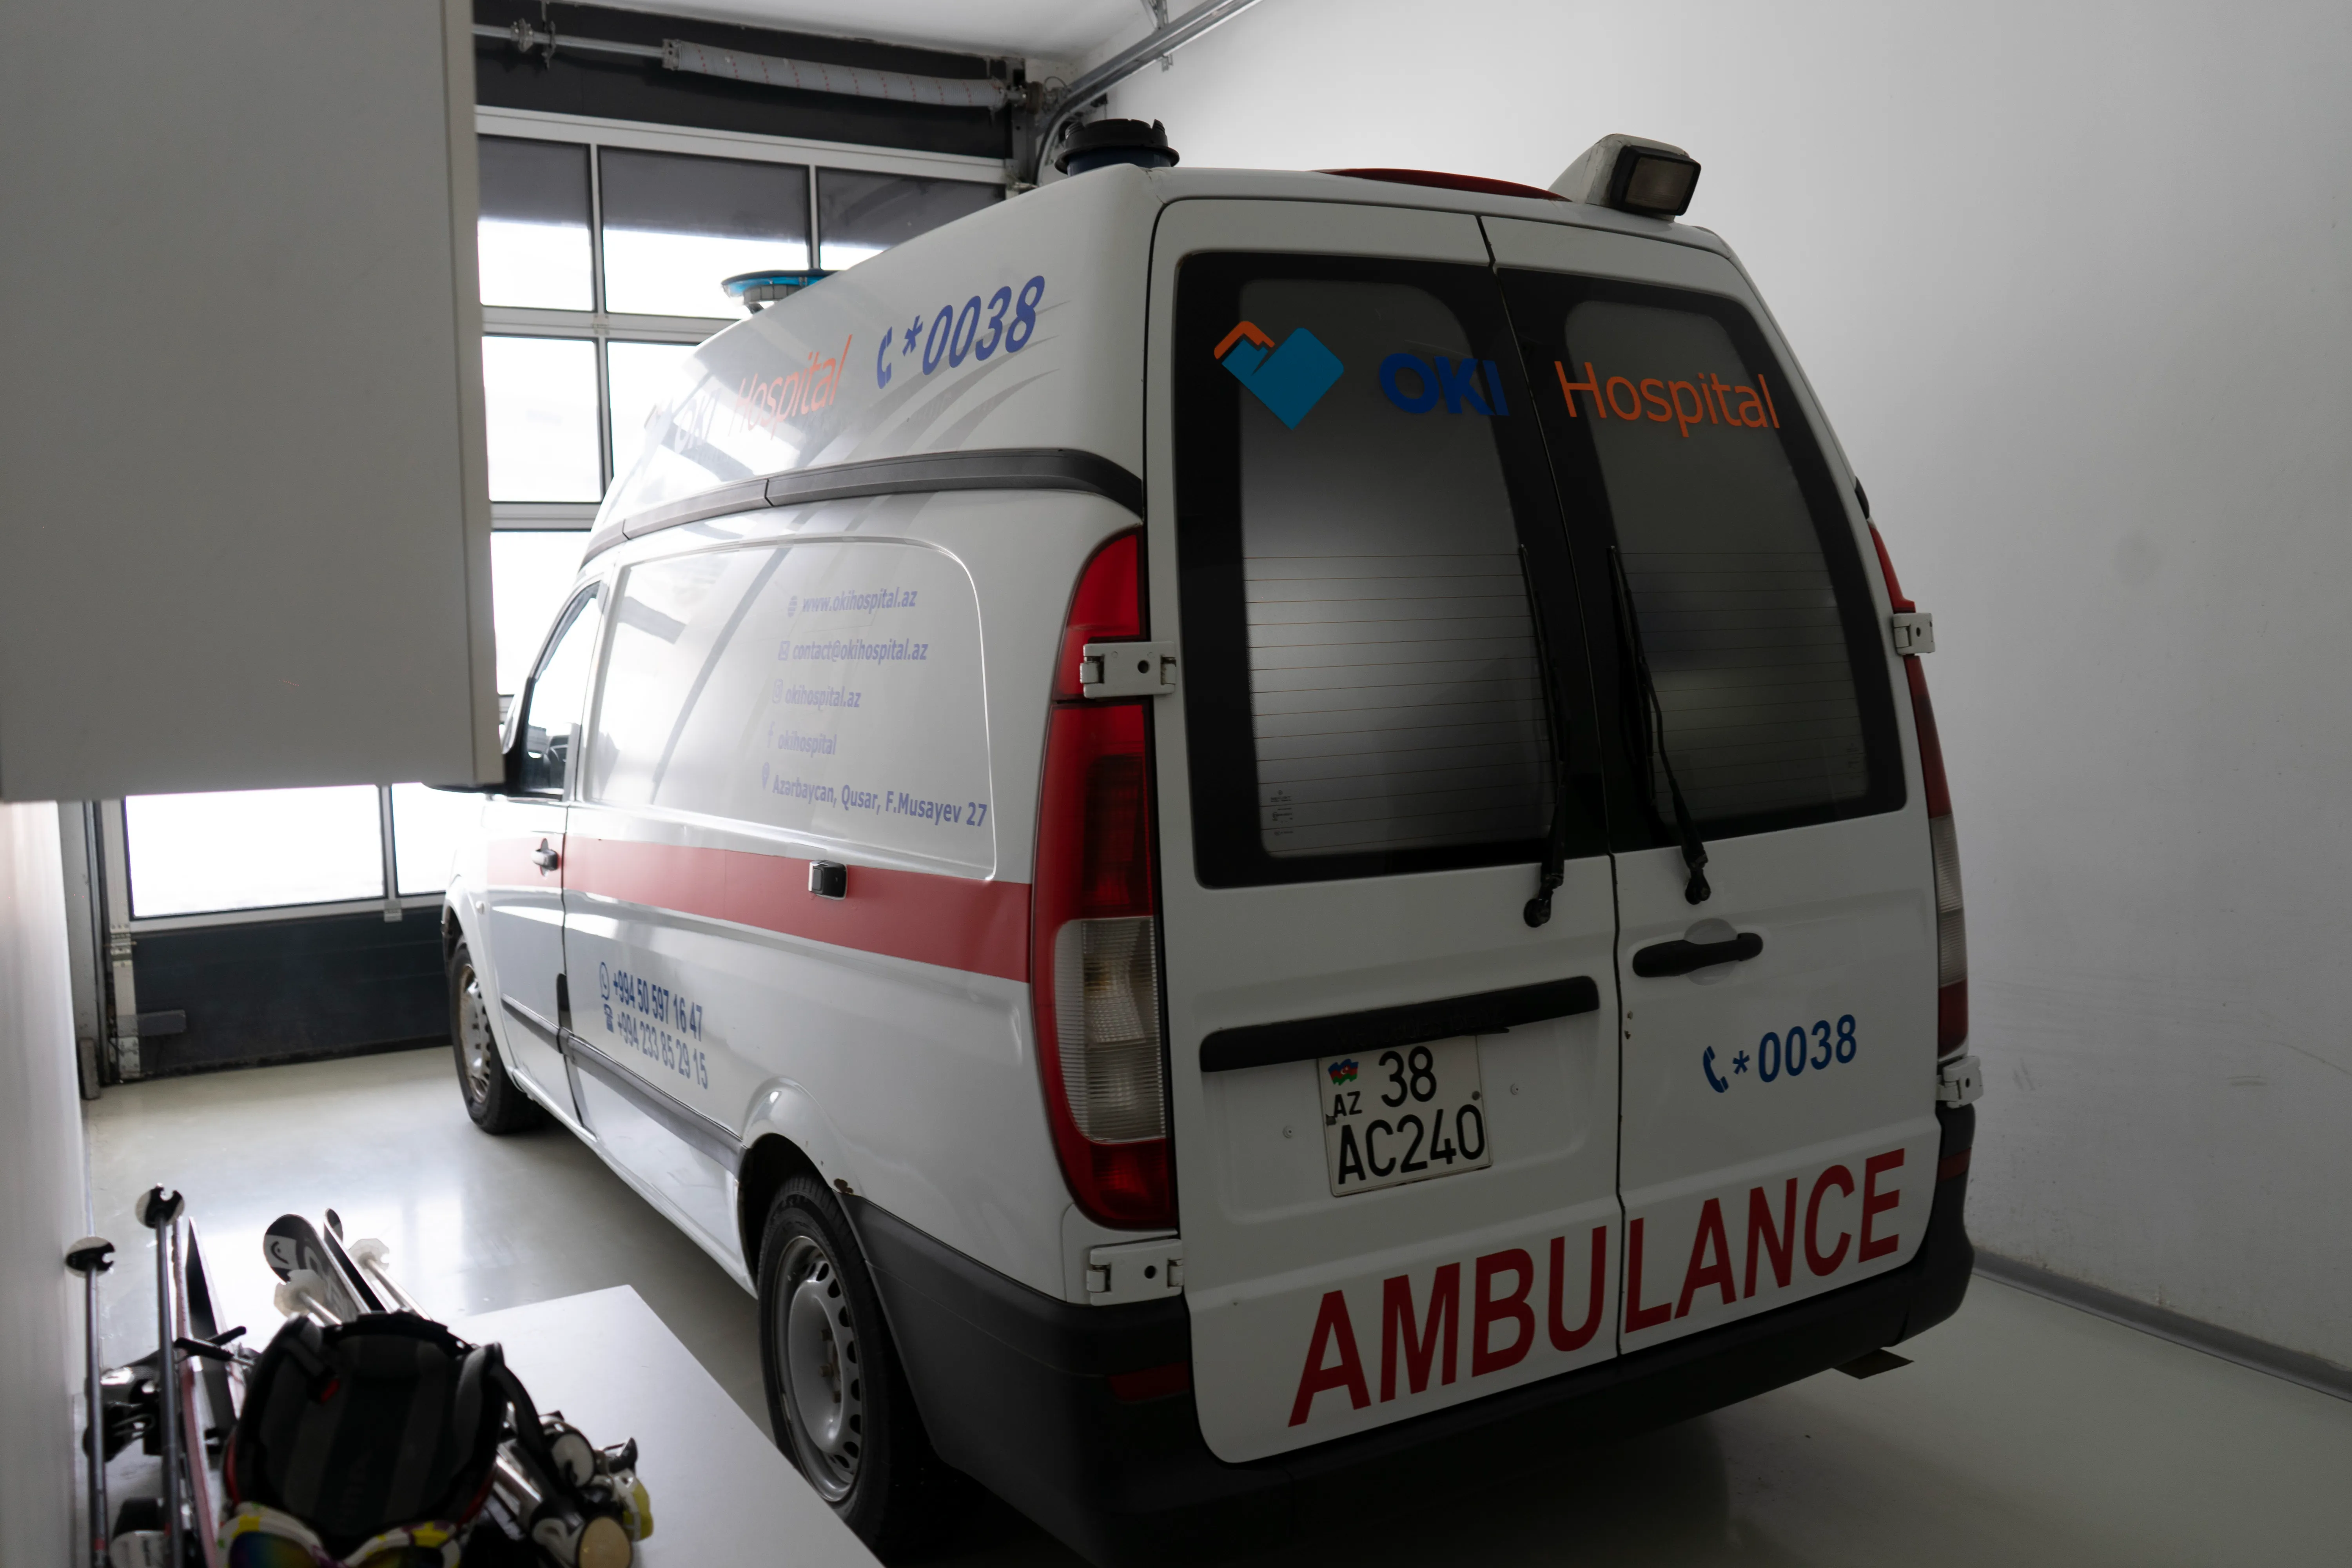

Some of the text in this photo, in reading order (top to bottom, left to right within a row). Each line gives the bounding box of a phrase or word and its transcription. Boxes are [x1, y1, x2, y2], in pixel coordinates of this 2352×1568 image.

[728, 334, 853, 441] Hospital
[1379, 352, 1780, 438] OKI Hospital
[802, 586, 918, 614] www.okihospital.az
[792, 638, 929, 665] contact@okihospital.az
[785, 686, 862, 711] okihospital.az
[778, 730, 837, 758] okihospital
[841, 785, 881, 815] Qusar,
[886, 791, 962, 826] F.Musayev
[966, 802, 988, 827] 27
[613, 969, 703, 1042] +994 50 597 16 47
[617, 1011, 708, 1090] +994 233 85 29 15
[1379, 1046, 1437, 1107] 38
[1334, 1091, 1363, 1116] AZ
[1338, 1104, 1485, 1185] AC240
[1288, 1148, 1906, 1427] AMBULANCE
